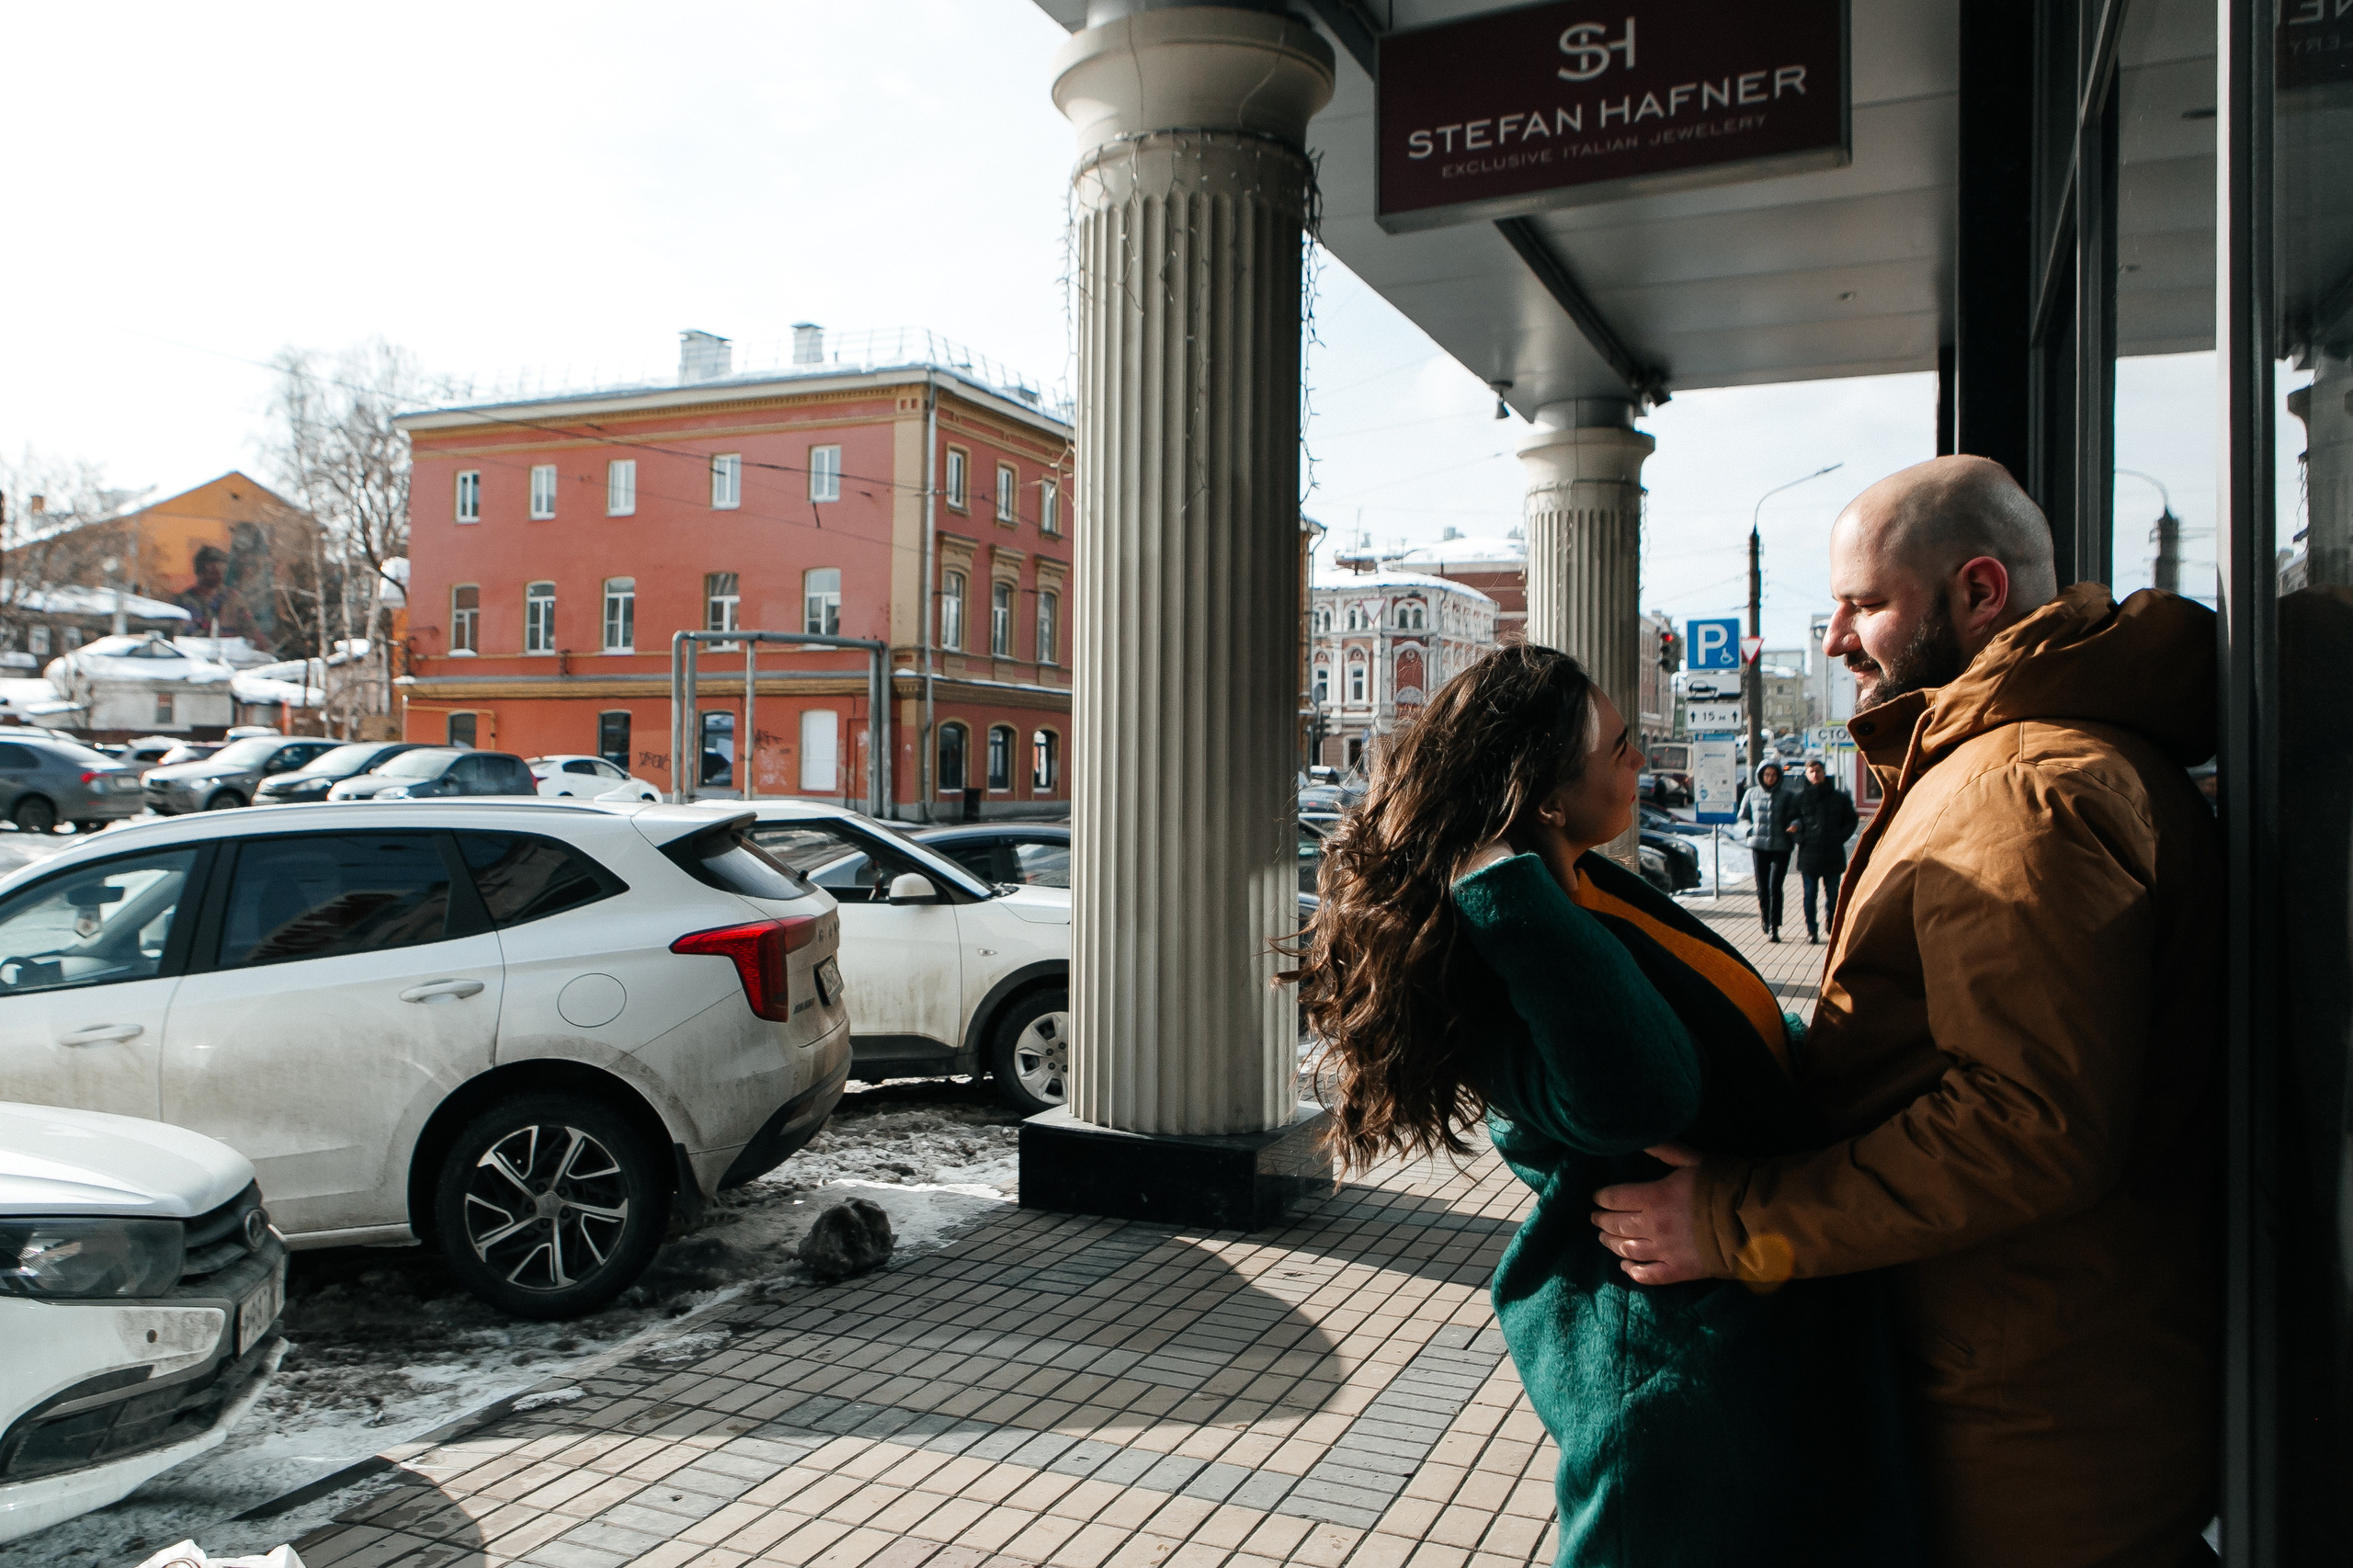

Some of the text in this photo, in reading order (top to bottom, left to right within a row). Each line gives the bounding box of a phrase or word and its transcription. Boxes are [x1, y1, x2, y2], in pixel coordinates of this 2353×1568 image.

[1408, 65, 1807, 160] STEFAN HAFNER
[1441, 114, 1768, 179] EXCLUSIVE ITALIAN JEWELERY
[1698, 623, 1729, 665] P
[1702, 710, 1716, 722] 15
